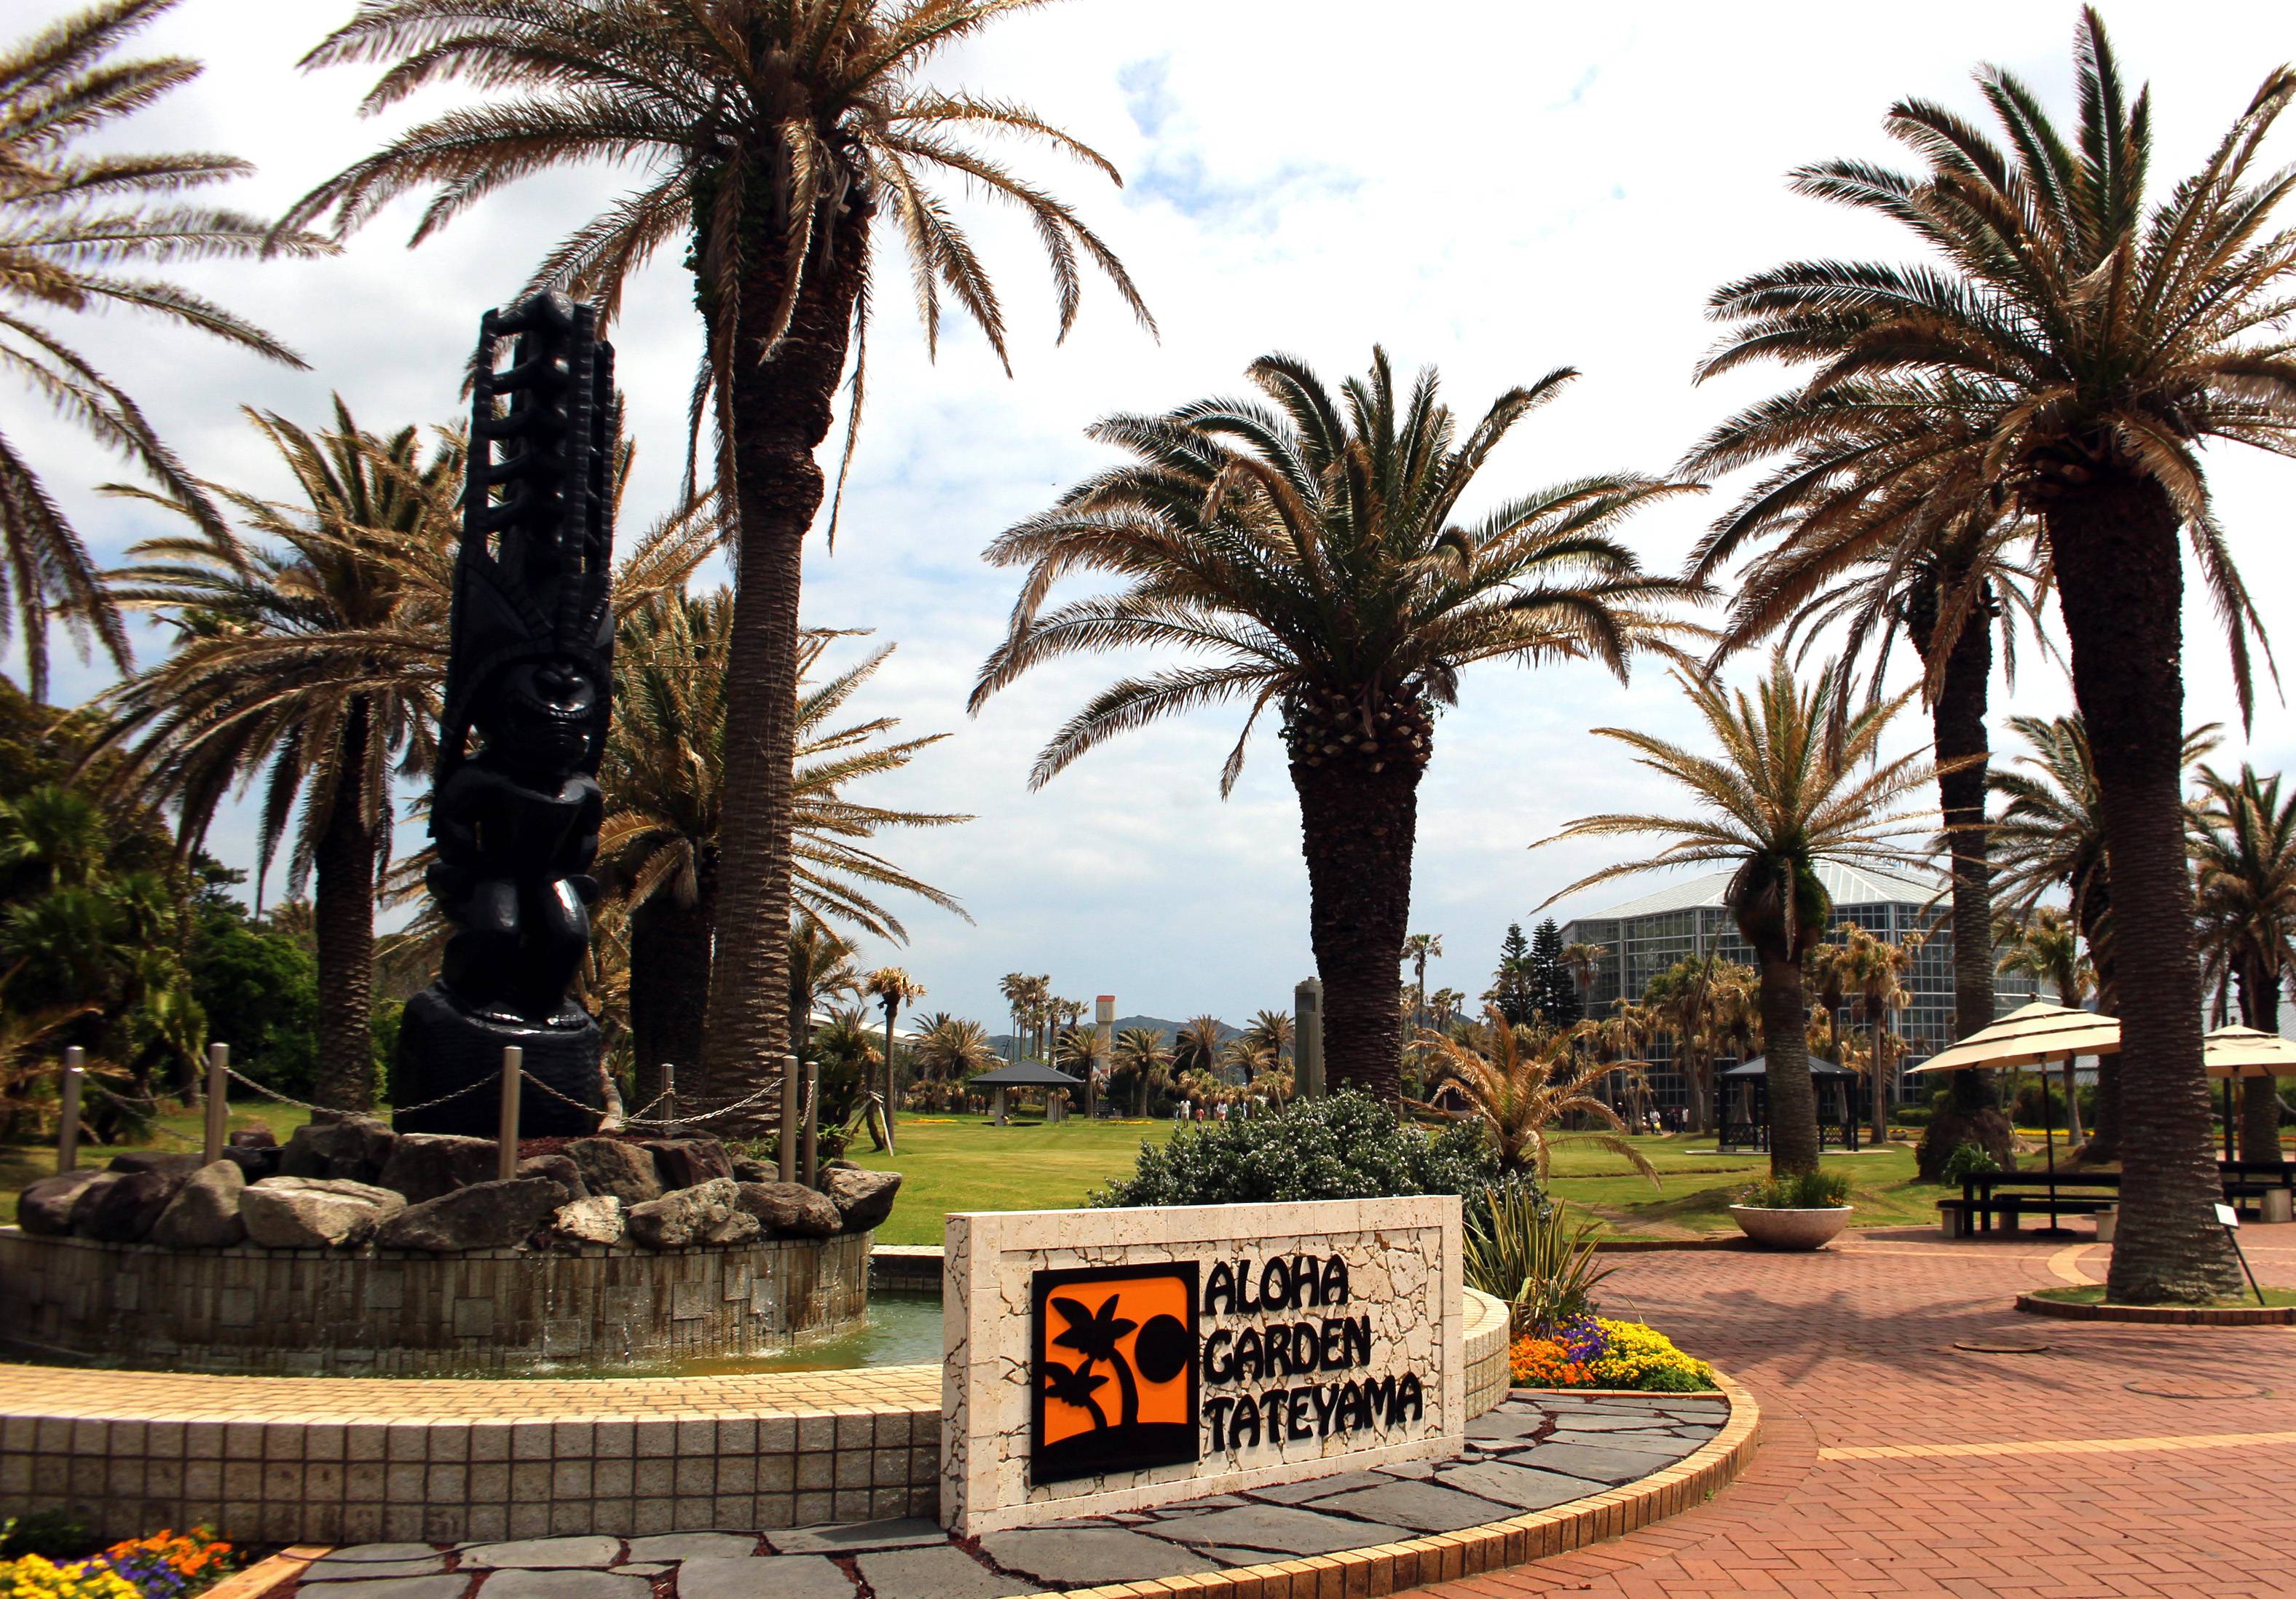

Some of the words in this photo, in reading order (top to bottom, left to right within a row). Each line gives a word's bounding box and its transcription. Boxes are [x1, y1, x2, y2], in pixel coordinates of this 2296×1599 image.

[1205, 1254, 1349, 1315] ALOHA
[1203, 1315, 1371, 1383] GARDEN
[1203, 1372, 1424, 1452] TATEYAMA
